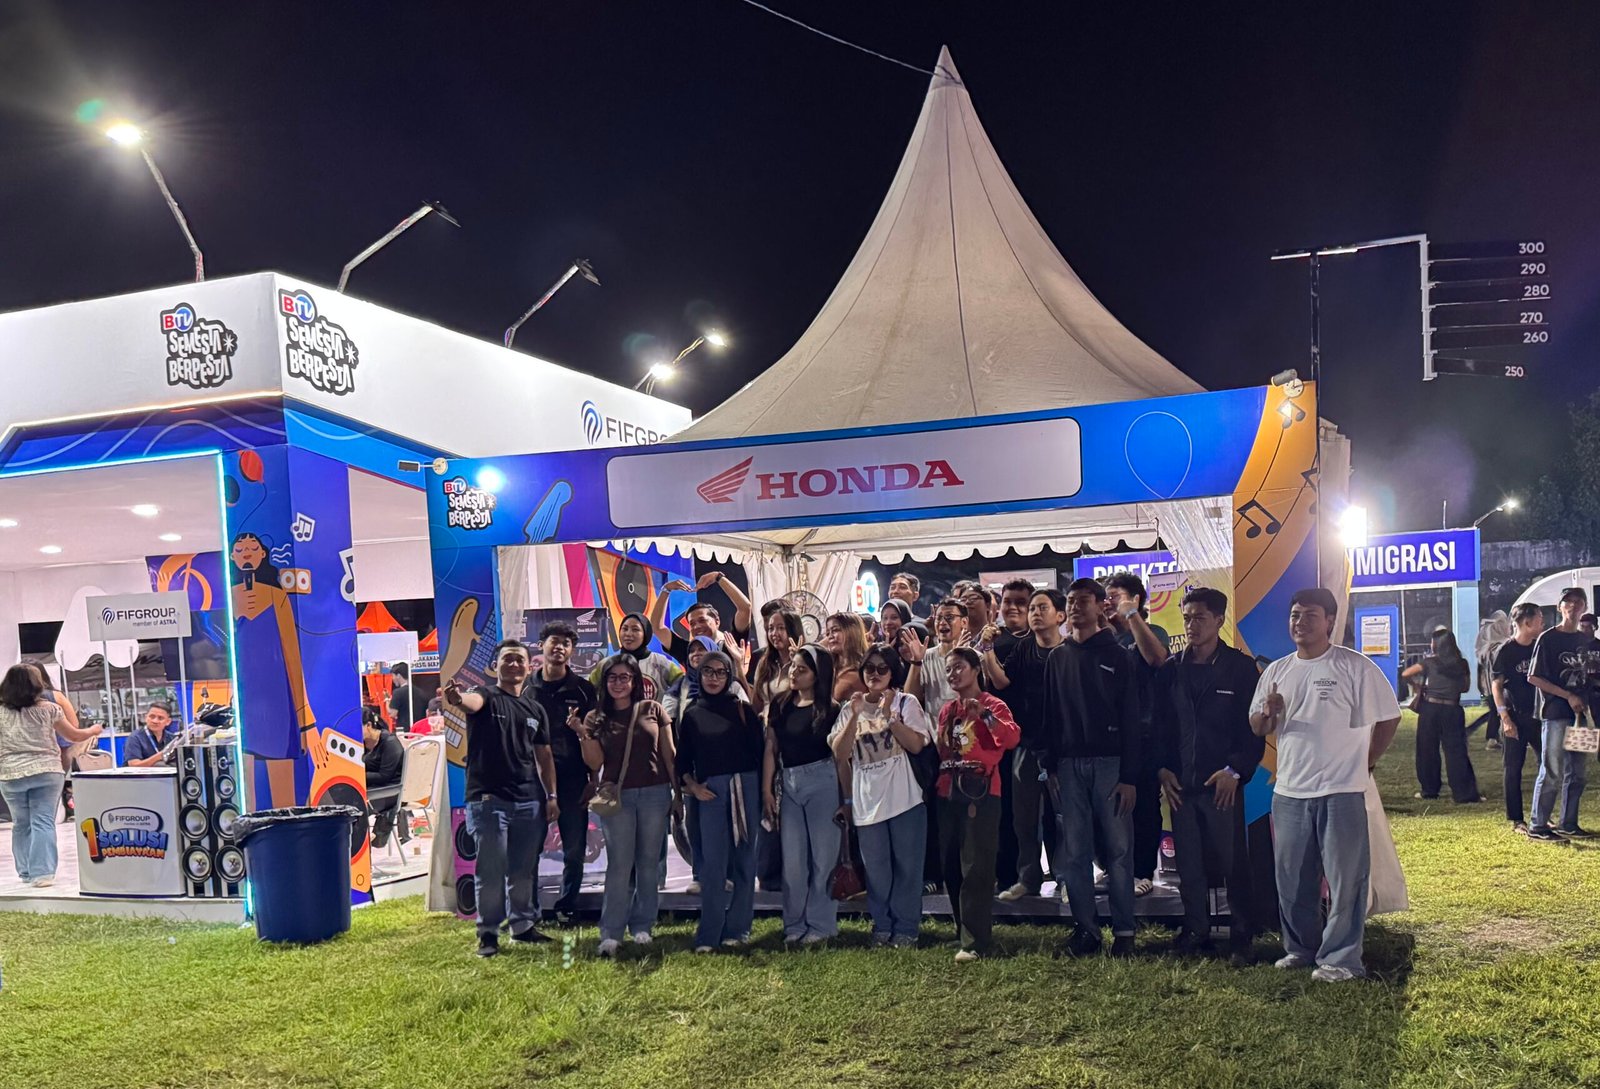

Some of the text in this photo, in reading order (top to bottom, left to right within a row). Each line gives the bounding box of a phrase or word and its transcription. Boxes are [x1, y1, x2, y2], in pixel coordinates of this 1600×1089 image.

[1519, 242, 1545, 254] 300
[1520, 263, 1546, 275] 290
[1524, 284, 1549, 297] 280
[283, 296, 314, 321] BTV
[1520, 312, 1543, 324] 270
[164, 312, 193, 329] BTV
[169, 322, 224, 357] SEMESTA
[289, 317, 346, 360] SEMESTA
[1523, 331, 1548, 343] 260
[168, 354, 230, 385] BERPESTA
[290, 348, 352, 391] BERPESTA
[1505, 366, 1524, 377] 250
[755, 459, 965, 500] HONDA
[116, 607, 176, 621] FIFGROUP
[81, 818, 99, 858] 1
[99, 829, 169, 852] SOLUSI
